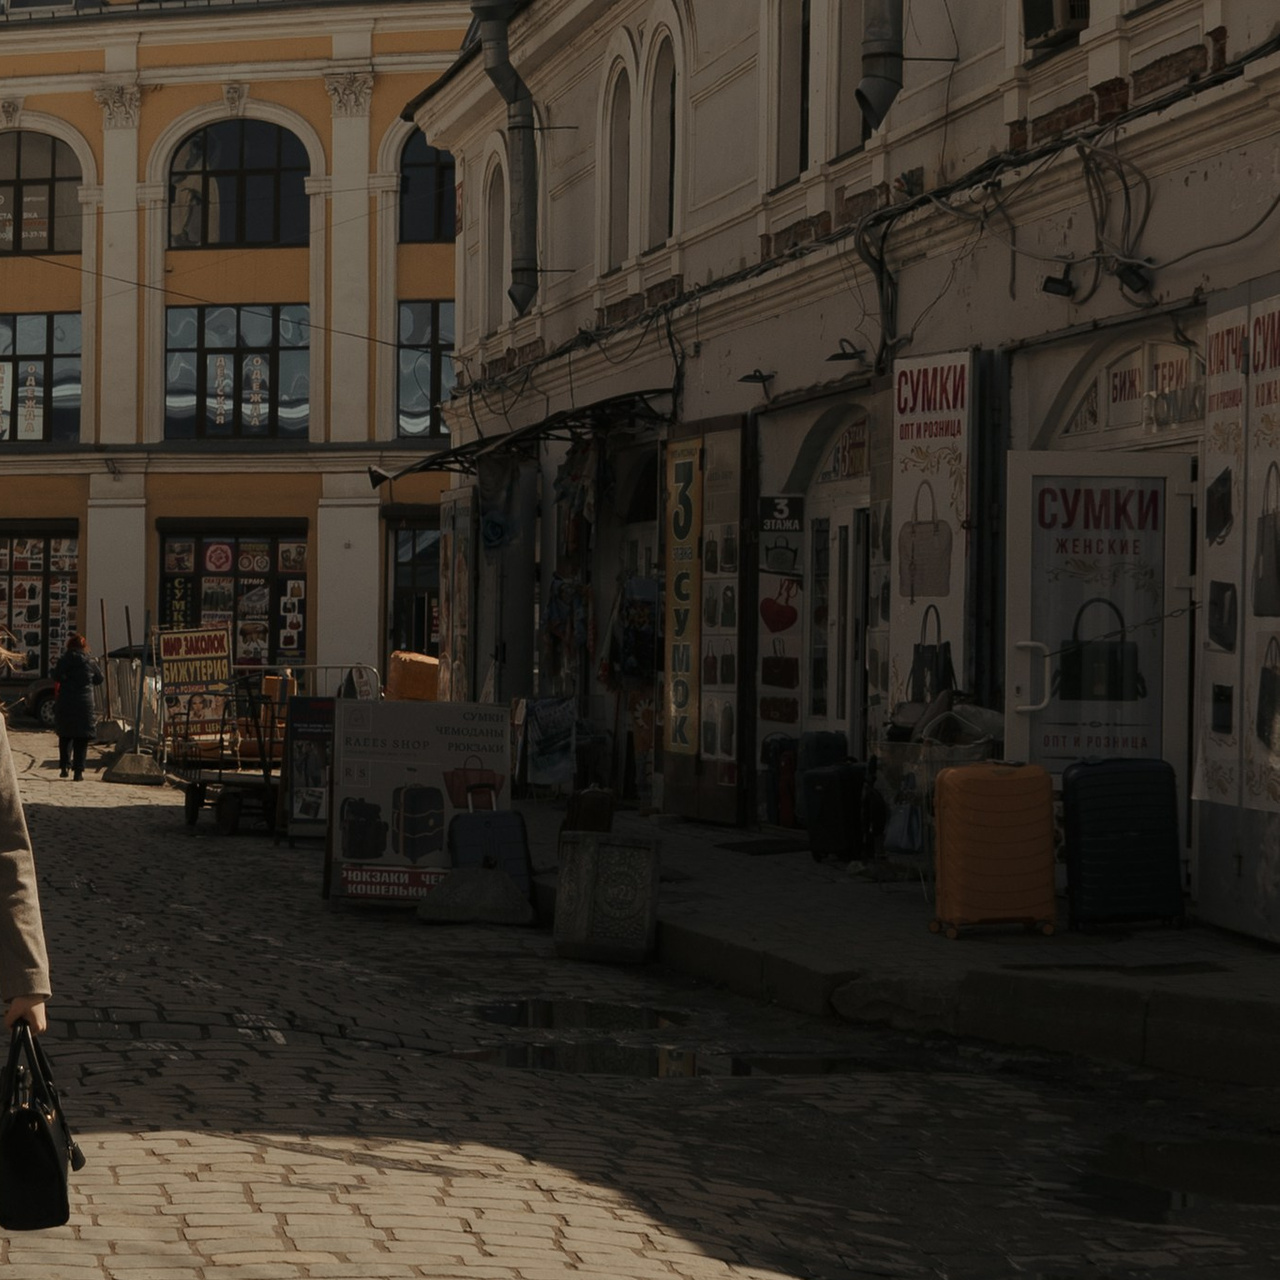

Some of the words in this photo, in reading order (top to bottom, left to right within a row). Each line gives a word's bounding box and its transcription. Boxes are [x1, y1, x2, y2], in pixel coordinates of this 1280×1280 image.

[24, 364, 36, 432] ОДЕЖДА
[215, 357, 225, 424] ДЕТСКАЯ
[250, 357, 262, 426] ОДЕЖДА
[897, 364, 965, 414] СУМКИ
[899, 422, 914, 441] ОПТ
[916, 421, 922, 439] И
[923, 418, 962, 439] РОЗНИЦА
[674, 461, 694, 540] 3
[773, 498, 790, 519] 3
[1037, 487, 1159, 531] СУМКИ
[763, 519, 800, 531] ЭТАЖА
[1055, 538, 1141, 555] ЖЕНСКИЕ
[240, 577, 265, 586] ТЕРМО
[162, 636, 182, 658] МИР
[184, 633, 227, 656] ЗАКОЛОК
[672, 571, 690, 747] СУМОК
[163, 658, 229, 684] БИЖУТЕРИЯ
[180, 684, 207, 694] РОЗНИЦА
[462, 711, 504, 723] СУМКИ
[435, 725, 505, 739] ЧЕМОДАНЫ
[1043, 734, 1067, 748] ОПТ
[1073, 735, 1081, 747] И
[1086, 735, 1148, 750] РОЗНИЦА
[392, 739, 431, 750] SHOP
[447, 742, 505, 754] РЮКЗАКИ
[347, 883, 428, 897] КОШЕЛЬКИ
